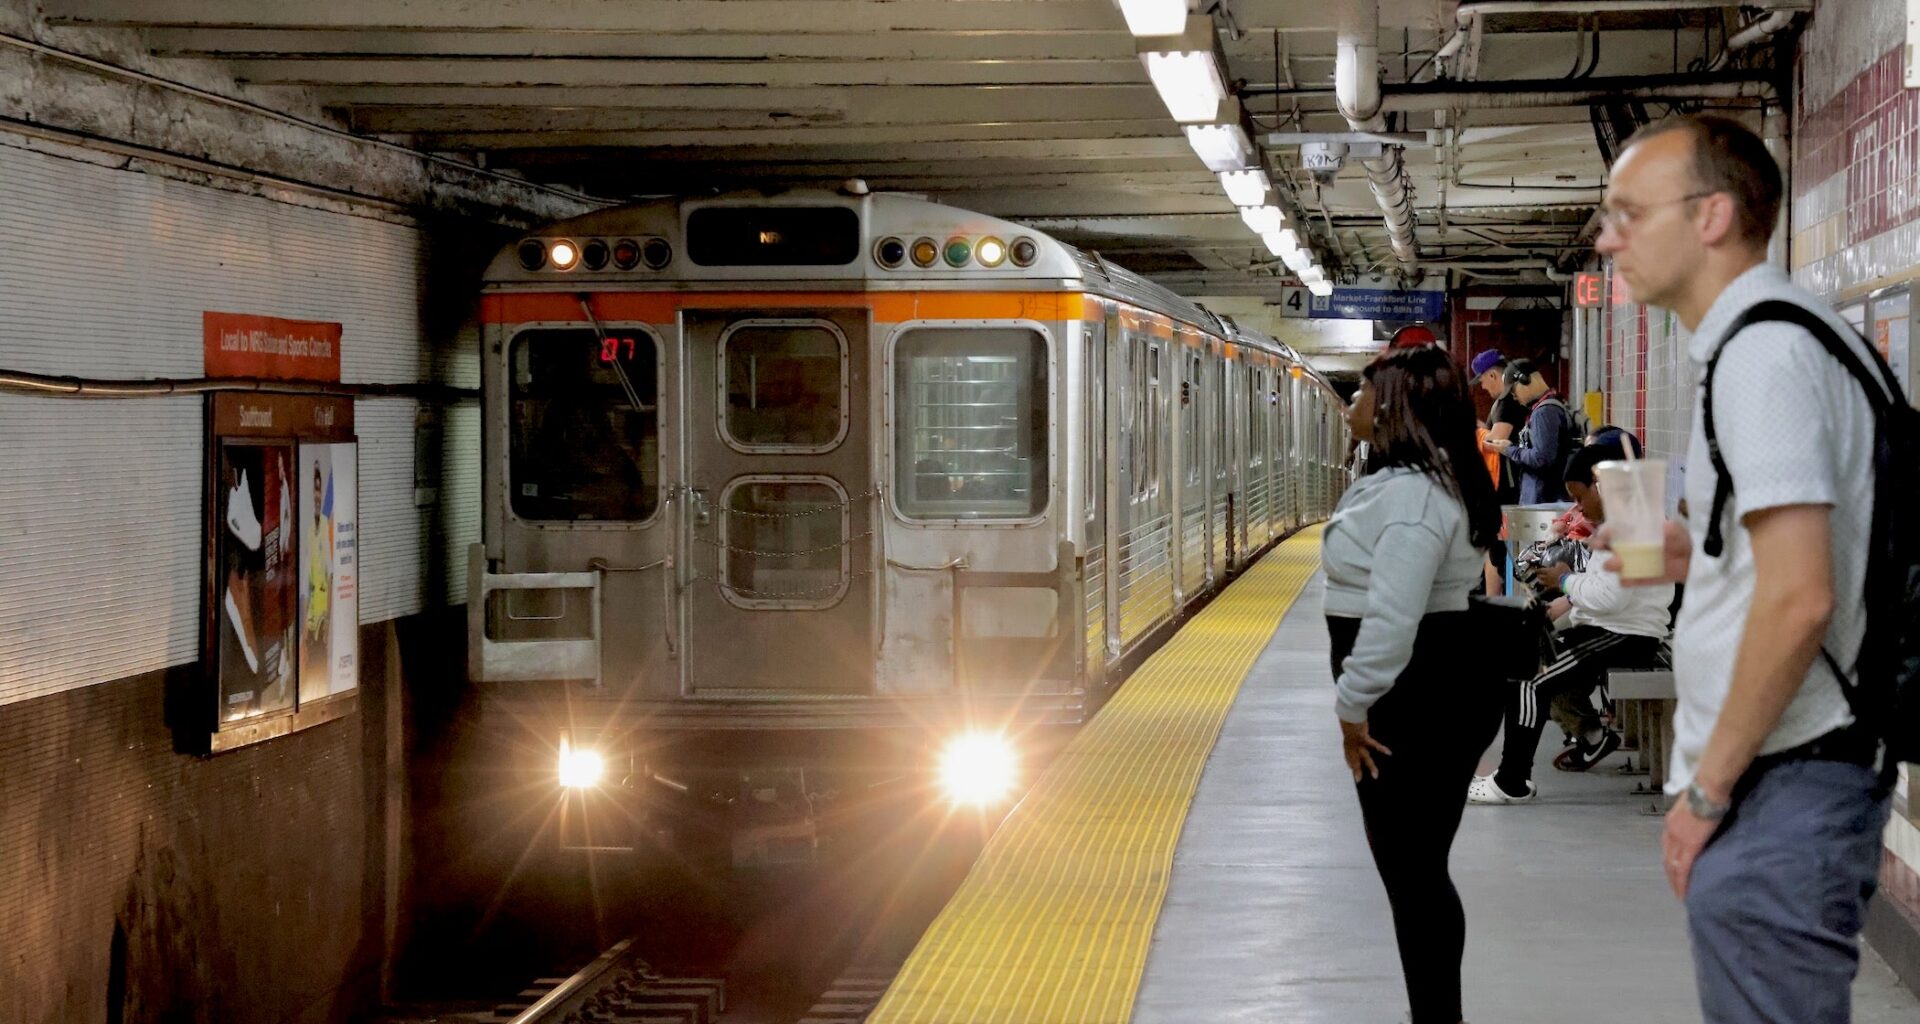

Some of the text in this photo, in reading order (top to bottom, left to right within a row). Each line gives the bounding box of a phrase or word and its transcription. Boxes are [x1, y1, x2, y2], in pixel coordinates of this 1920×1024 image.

[1851, 118, 1883, 233] CITY
[1287, 290, 1302, 311] 4
[1333, 293, 1426, 304] Market-Frankford Line
[1382, 305, 1391, 313] to
[1413, 306, 1424, 314] St
[220, 329, 240, 351] Local
[601, 338, 635, 362] 07
